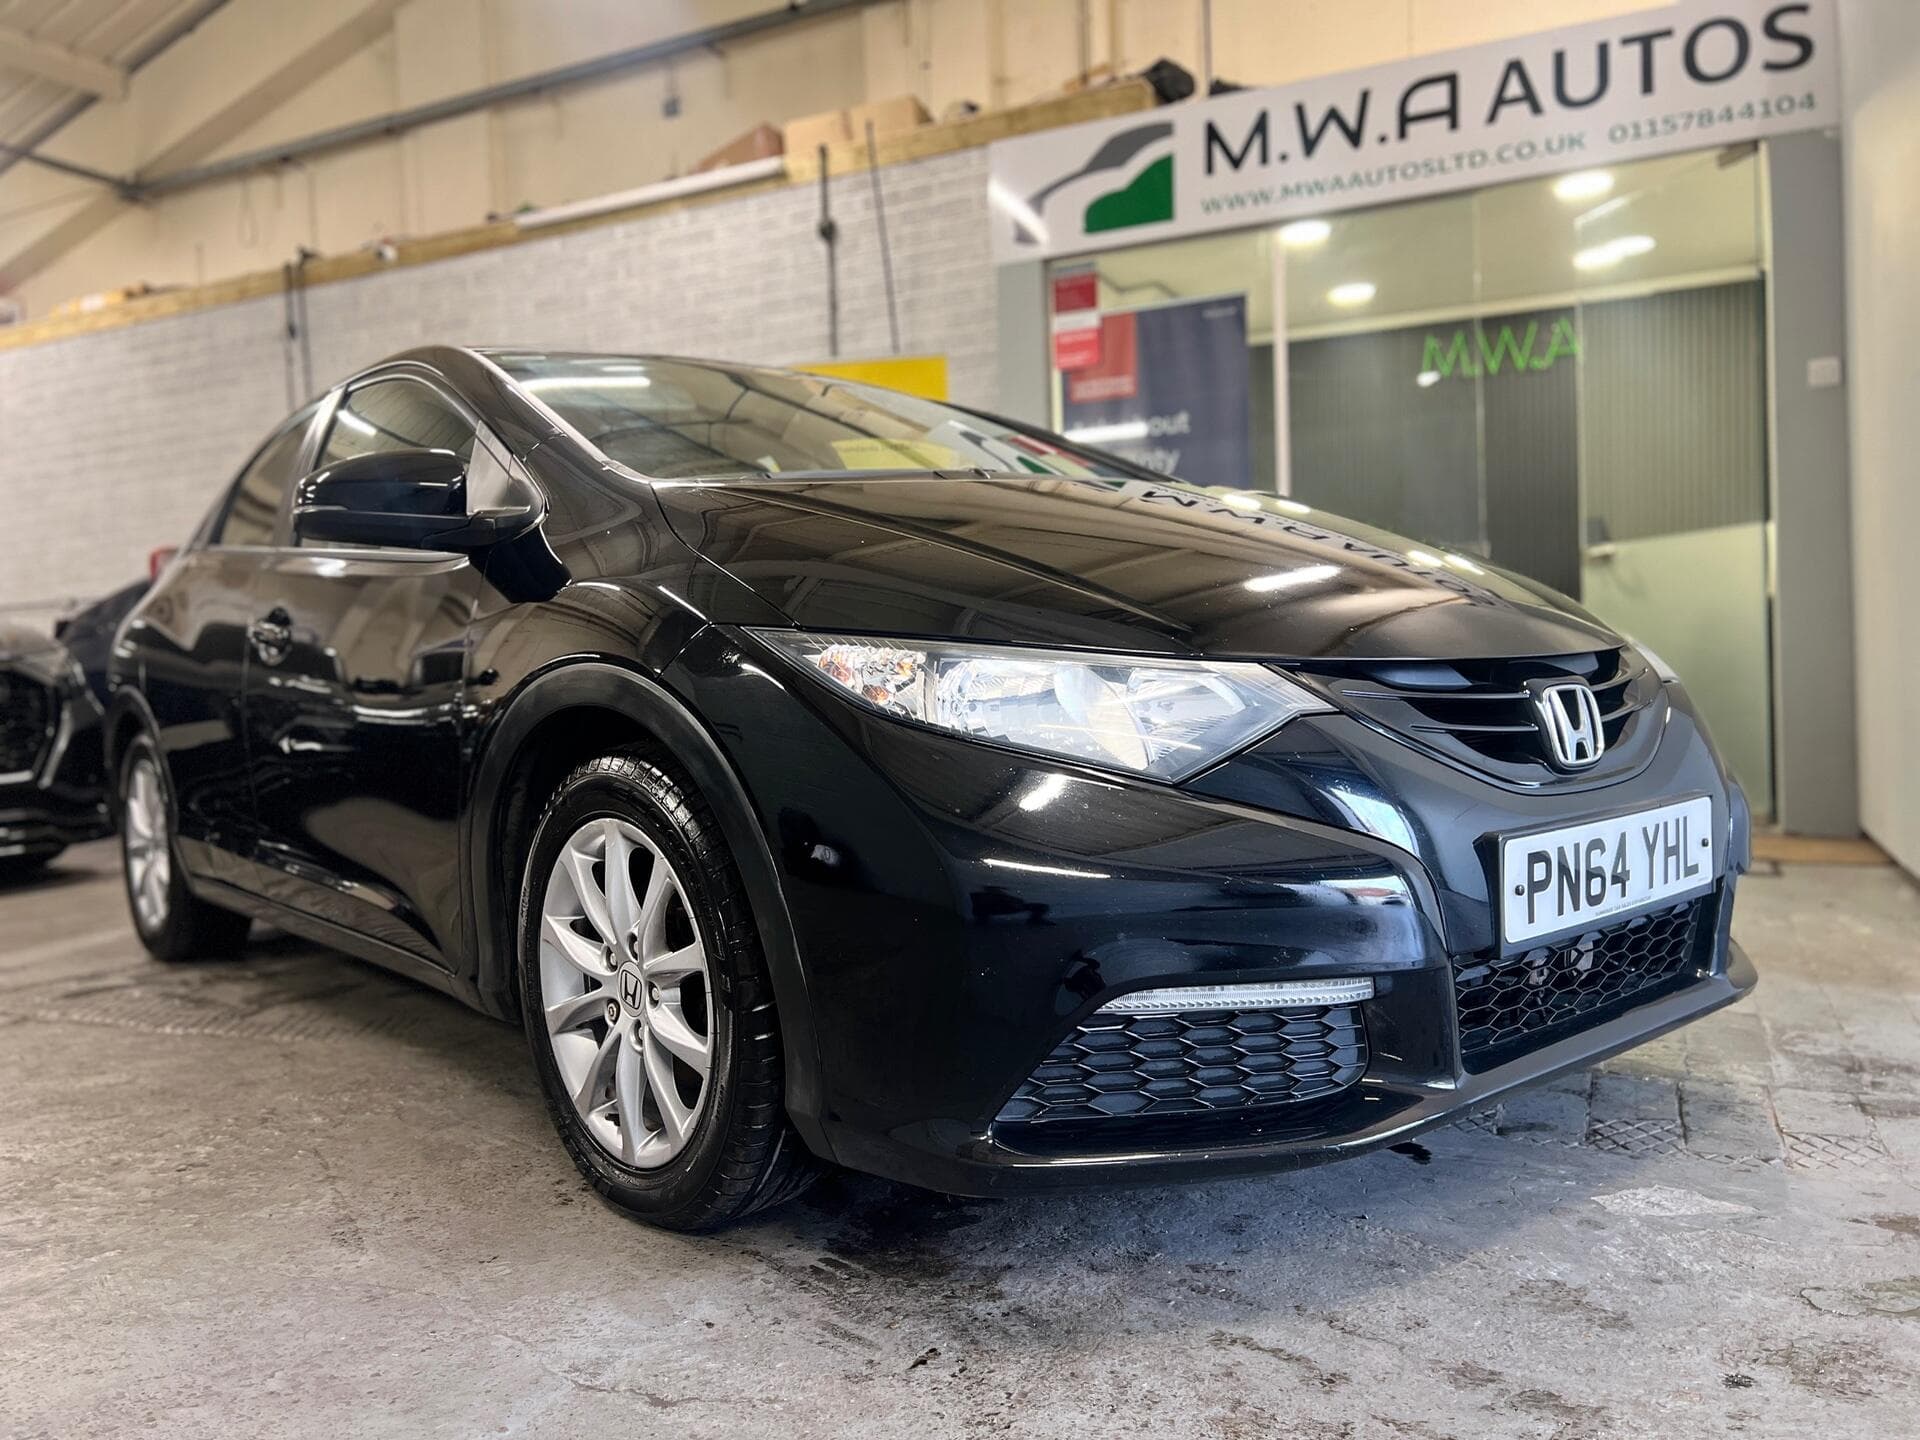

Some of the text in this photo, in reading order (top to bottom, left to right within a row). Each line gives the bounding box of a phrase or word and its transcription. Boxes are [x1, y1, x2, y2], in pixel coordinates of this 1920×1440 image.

[1205, 3, 1815, 175] M.W.A AUTOS
[1201, 92, 1816, 213] WWW.MWAAUTOSLTD.CO.UK 01157844104
[1527, 816, 1699, 925] PN64 YHL
